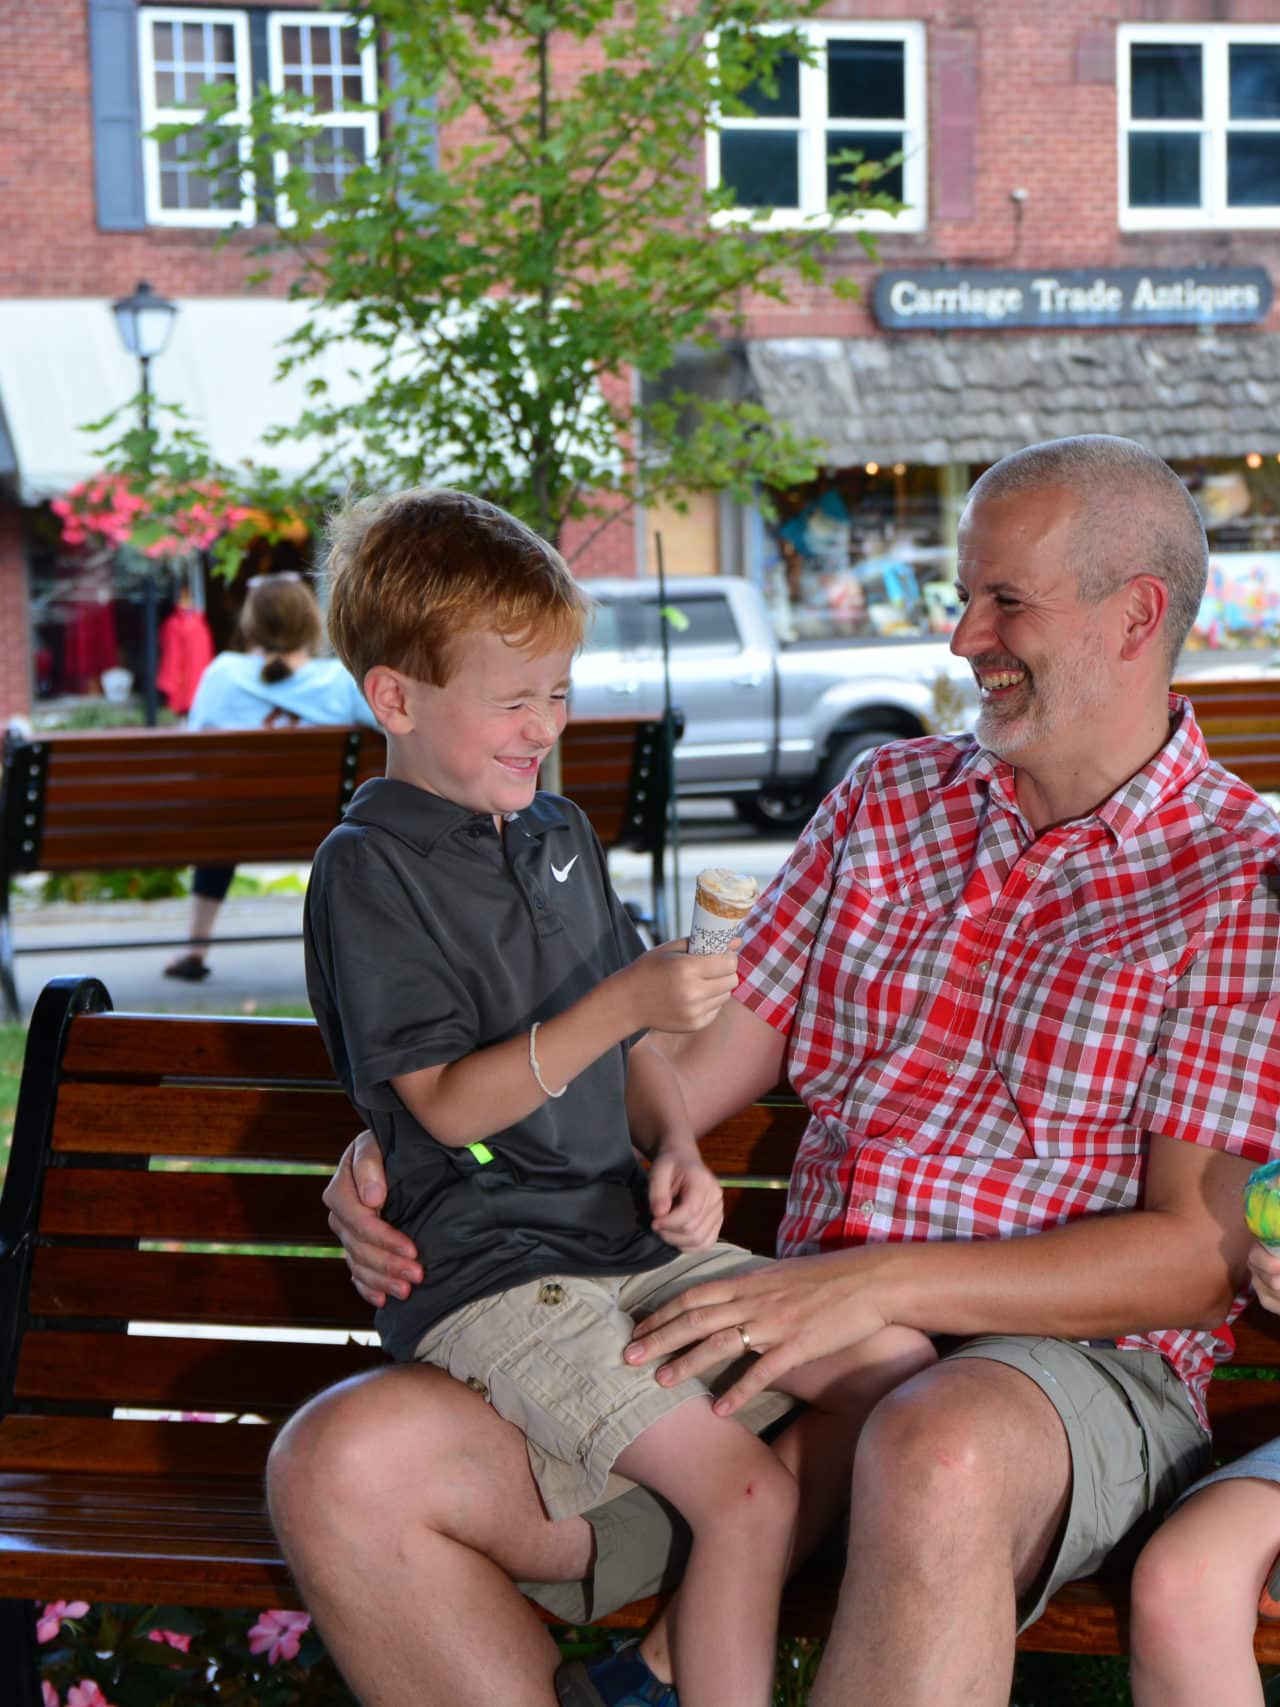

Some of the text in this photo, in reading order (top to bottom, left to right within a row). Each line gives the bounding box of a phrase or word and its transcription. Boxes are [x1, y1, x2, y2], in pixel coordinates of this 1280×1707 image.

[890, 277, 1260, 320] Carriage Trade Antiques
